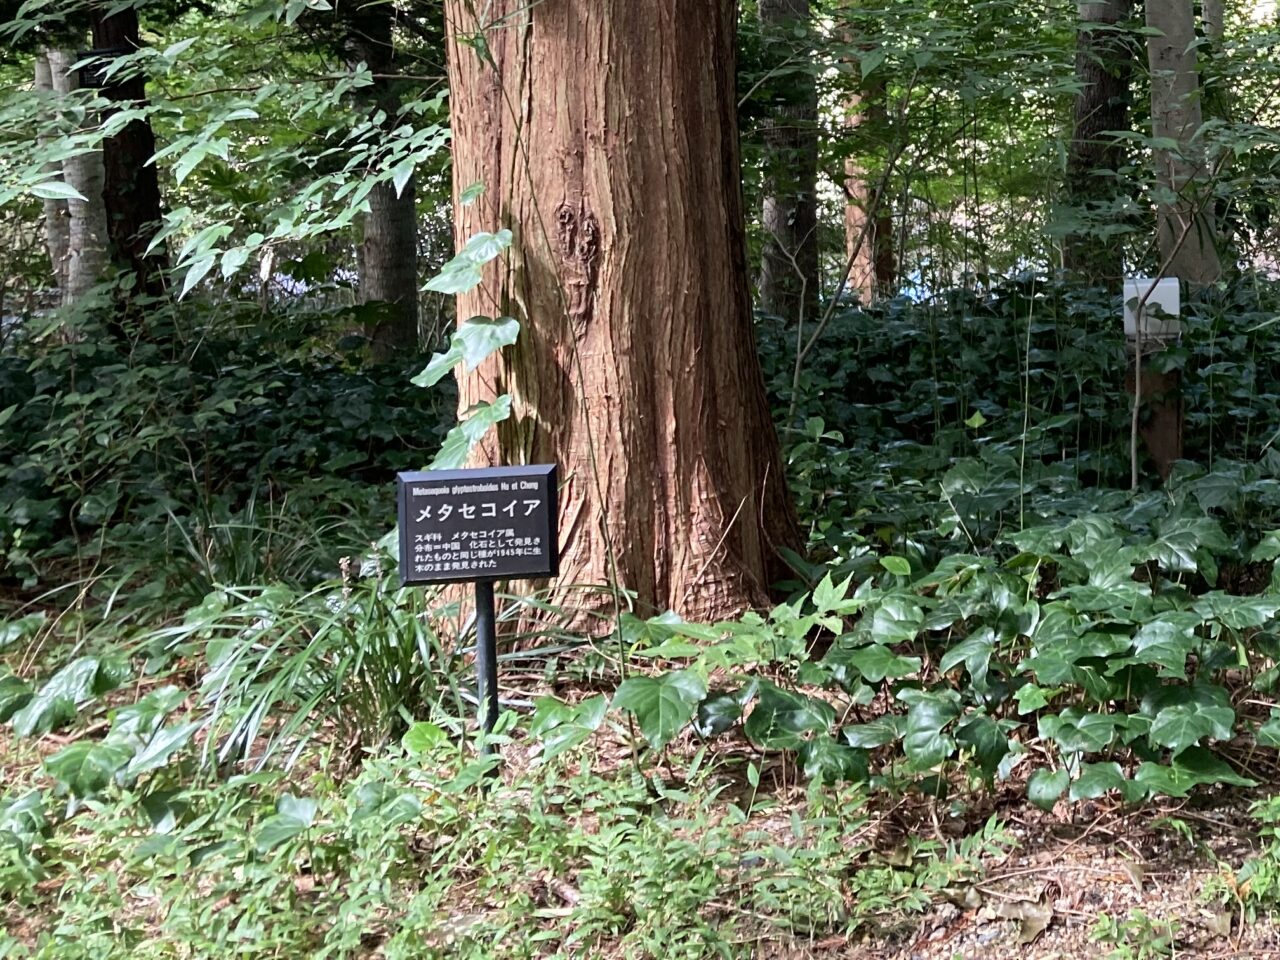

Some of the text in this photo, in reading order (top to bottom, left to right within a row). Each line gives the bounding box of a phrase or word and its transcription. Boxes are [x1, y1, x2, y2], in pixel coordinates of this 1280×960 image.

[415, 499, 541, 522] メタセコイア
[415, 532, 442, 543] スギ科
